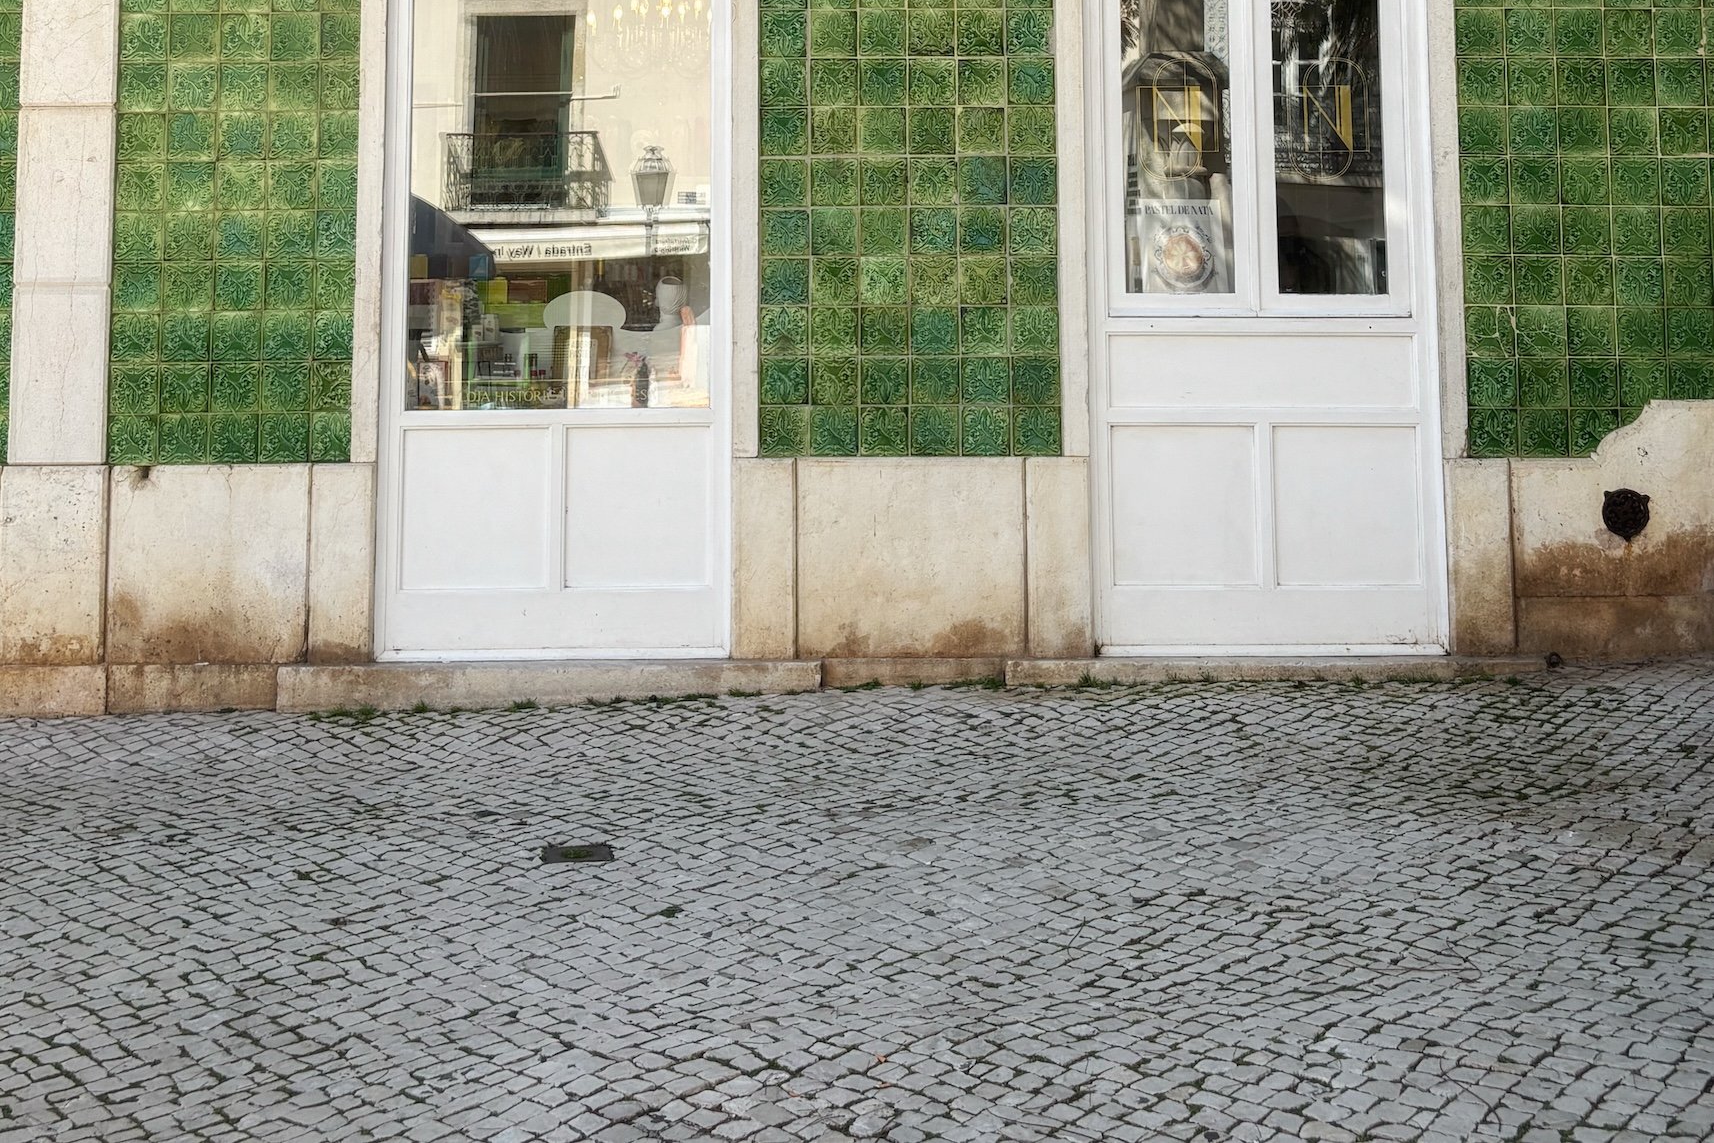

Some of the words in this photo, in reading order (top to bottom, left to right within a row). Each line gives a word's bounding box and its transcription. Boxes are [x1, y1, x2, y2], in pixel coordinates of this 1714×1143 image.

[1144, 204, 1177, 215] PASTEL
[1178, 204, 1190, 215] DE
[1190, 204, 1214, 216] NATA
